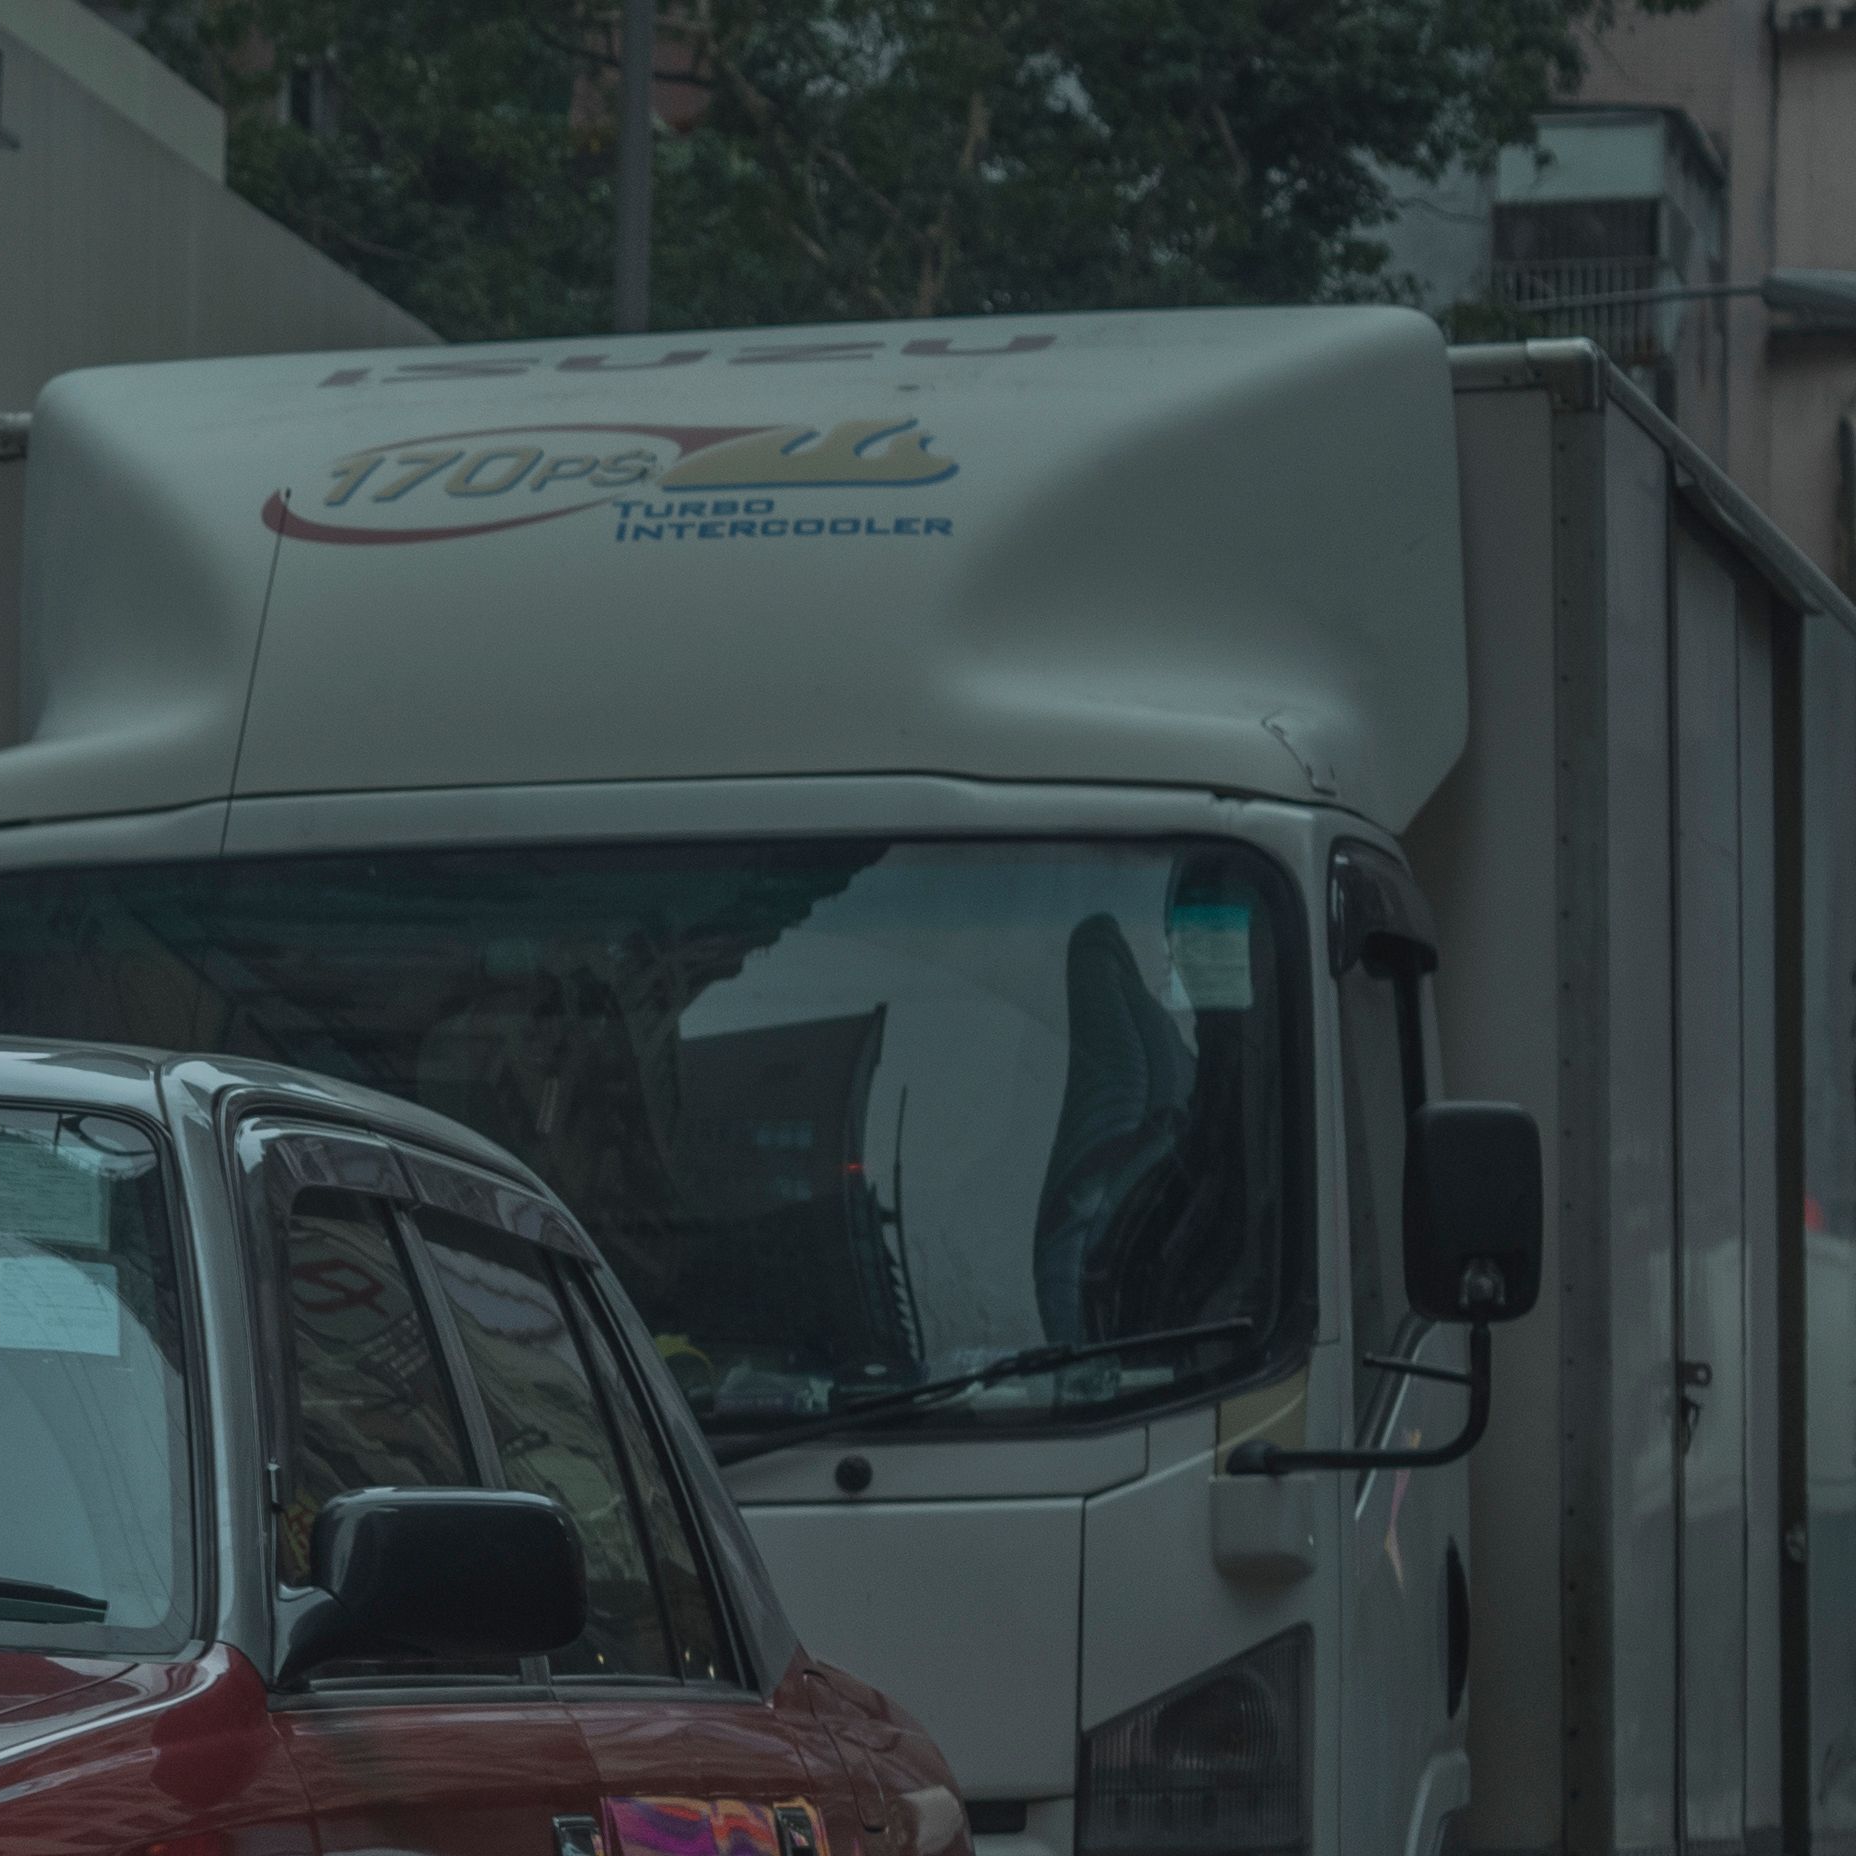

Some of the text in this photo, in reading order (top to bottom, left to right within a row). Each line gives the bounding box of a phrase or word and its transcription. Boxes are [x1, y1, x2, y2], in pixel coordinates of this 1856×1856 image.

[316, 334, 1058, 388] ISUZU
[612, 500, 775, 520] TURBO
[615, 516, 954, 543] INTERCOOLER
